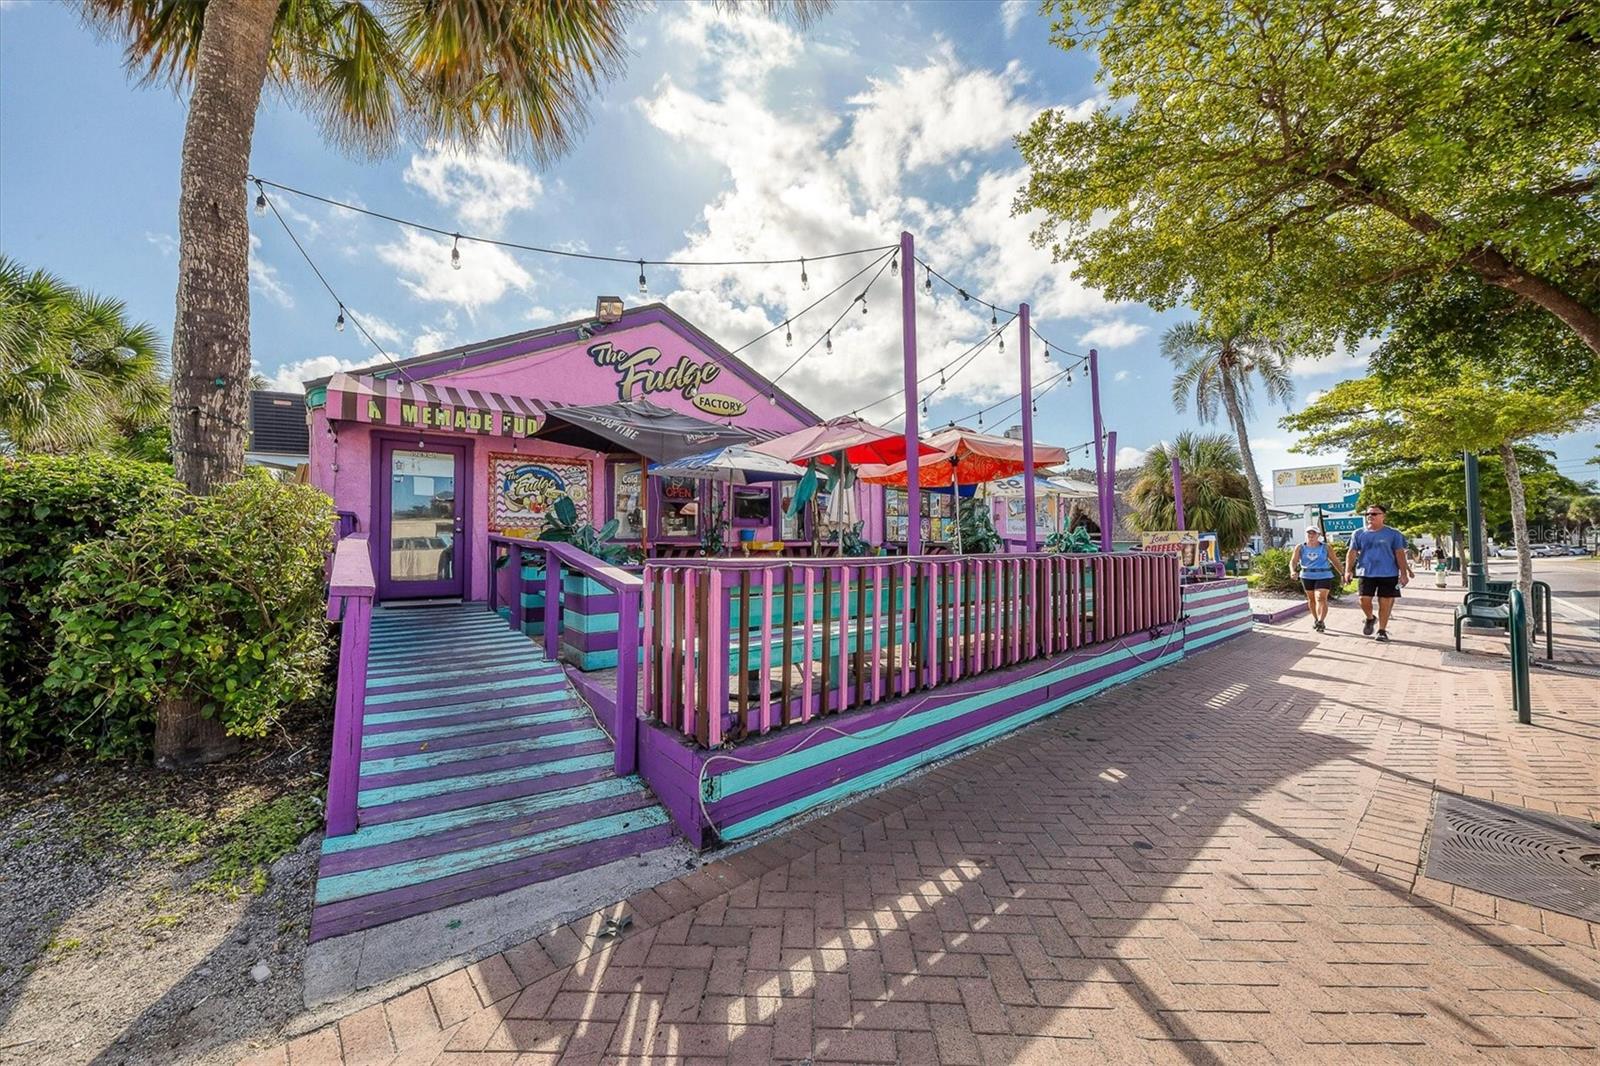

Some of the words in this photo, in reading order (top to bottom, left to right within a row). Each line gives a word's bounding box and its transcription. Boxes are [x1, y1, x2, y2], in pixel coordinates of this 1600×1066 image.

[588, 341, 628, 366] The
[614, 347, 721, 402] Fudge
[699, 396, 742, 412] FACTORY
[503, 415, 545, 436] FUD
[514, 473, 555, 496] Fudge
[622, 474, 638, 484] Cold
[665, 486, 692, 498] OPEN
